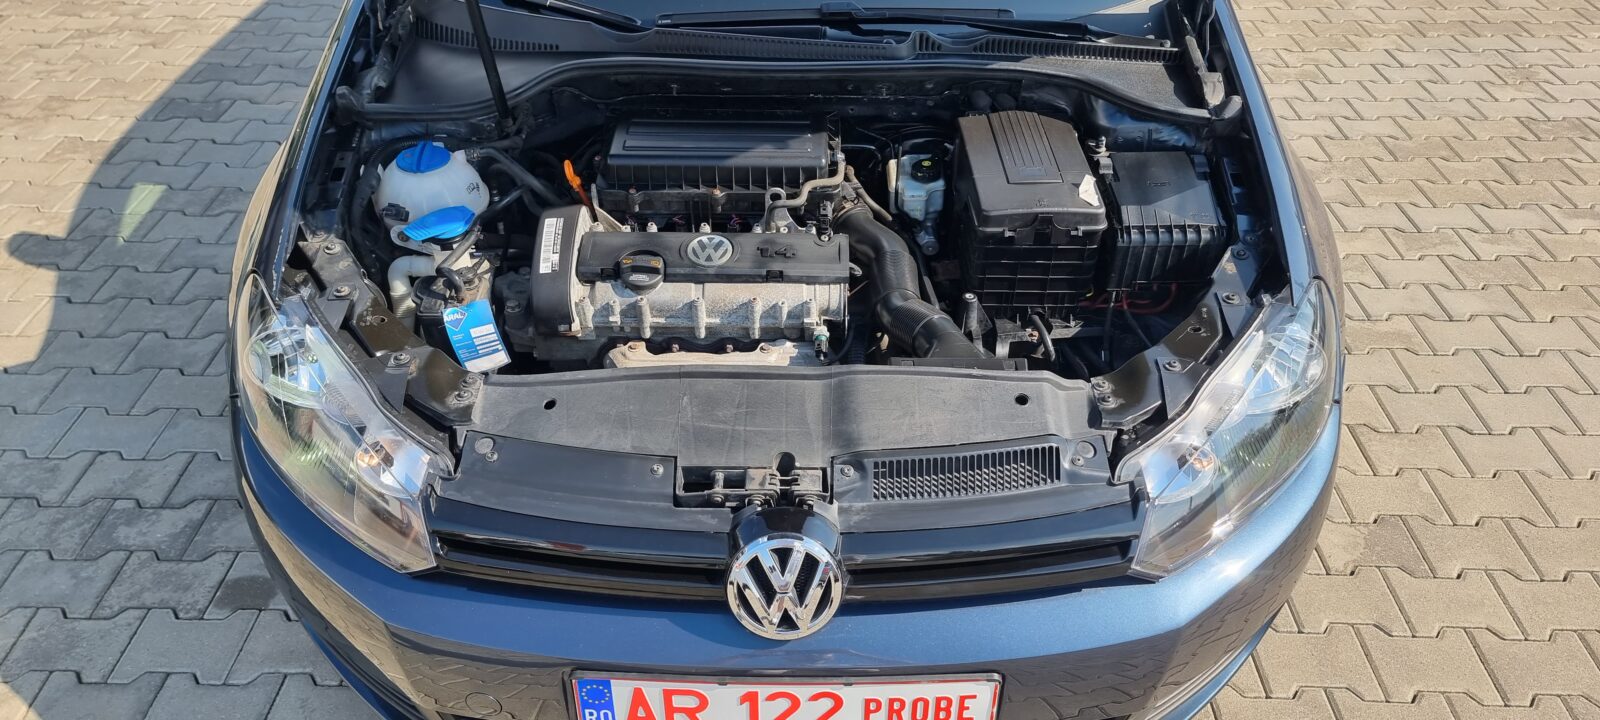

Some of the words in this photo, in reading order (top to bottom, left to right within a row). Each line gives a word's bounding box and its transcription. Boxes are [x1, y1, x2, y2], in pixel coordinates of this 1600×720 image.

[727, 532, 842, 640] VW
[626, 687, 709, 720] AR
[739, 691, 844, 720] 122
[863, 695, 977, 720] PROBE
